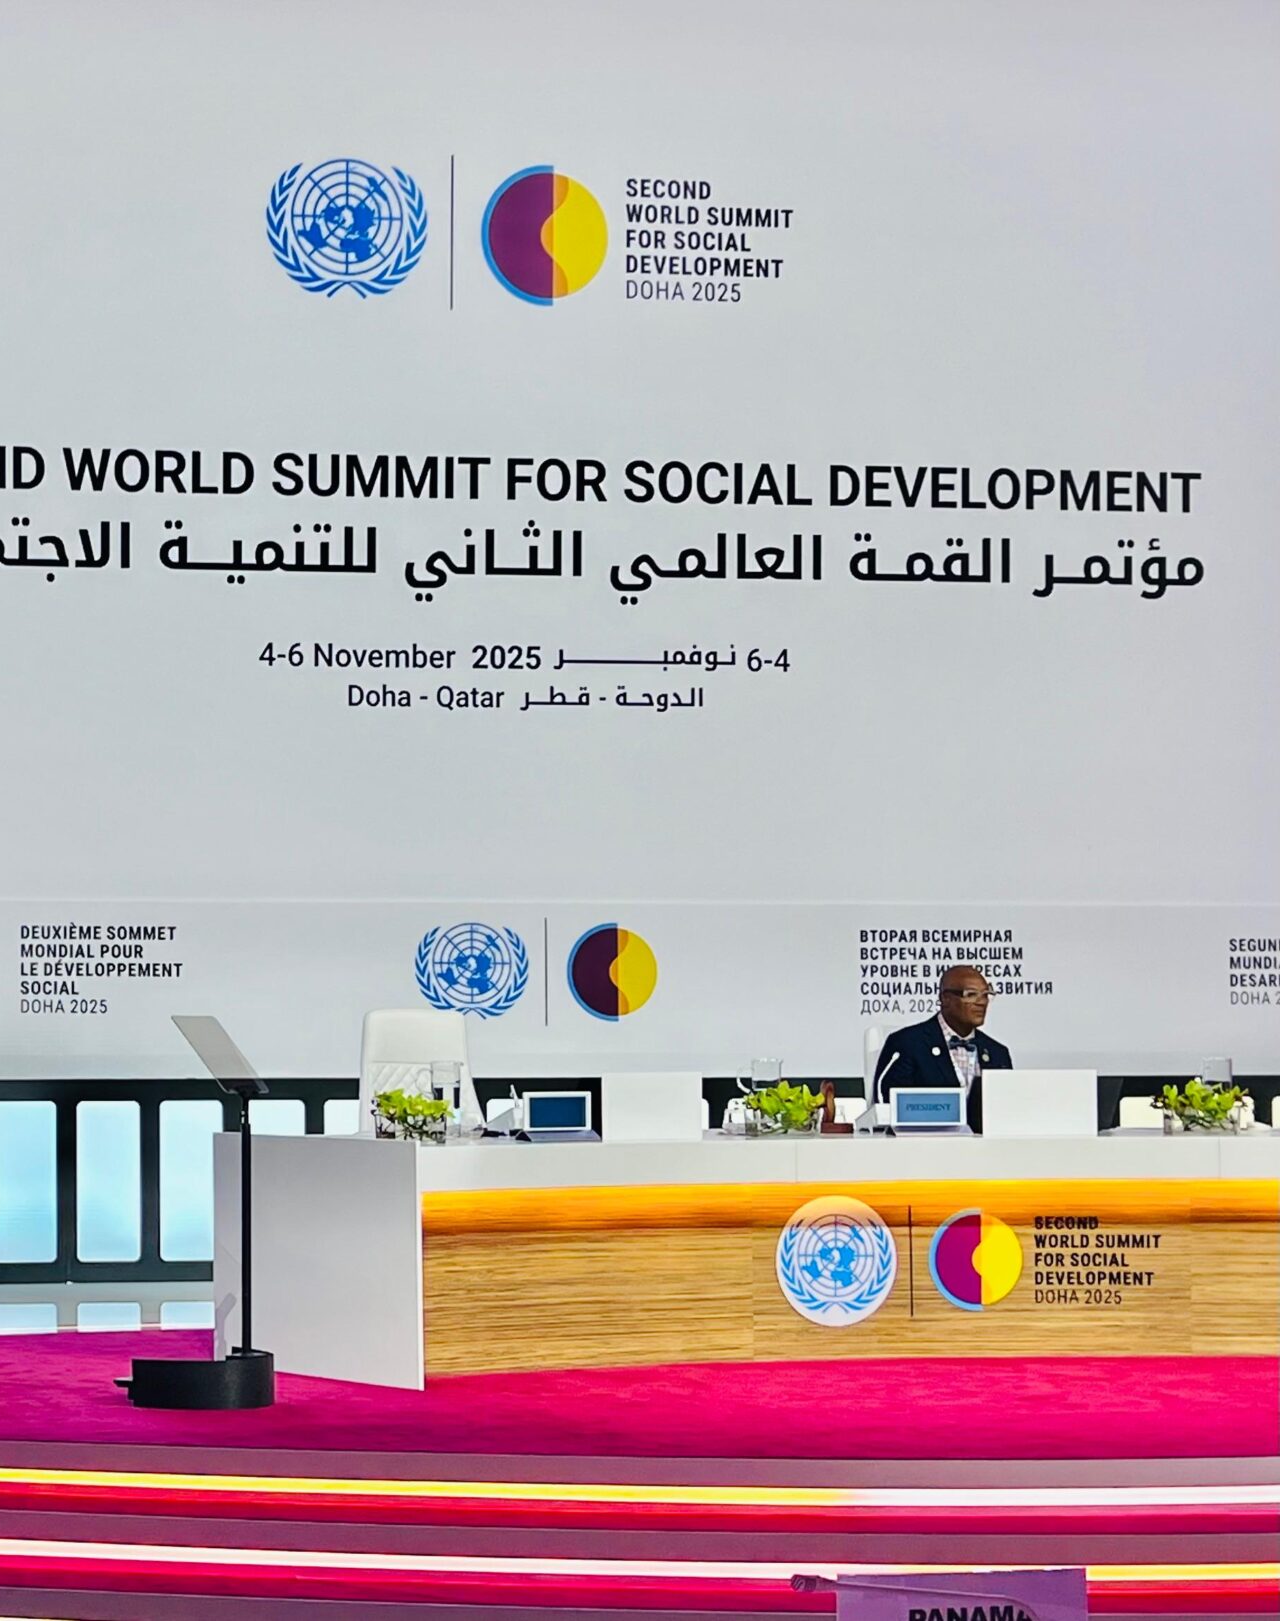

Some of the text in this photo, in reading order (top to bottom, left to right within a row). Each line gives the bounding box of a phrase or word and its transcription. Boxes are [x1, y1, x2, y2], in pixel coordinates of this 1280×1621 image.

[626, 179, 710, 199] SECOND
[626, 204, 793, 228] WORLD SUMMIT
[627, 230, 751, 252] FOR SOCIAL
[626, 255, 783, 279] DEVELOPMENT
[627, 280, 740, 302] DOHA 2025
[63, 448, 254, 494] WORLD
[272, 453, 491, 499] SUMMIT
[507, 458, 607, 501] FOR
[624, 460, 812, 505] SOCIAL
[830, 465, 1201, 513] DEVELOPMENT
[160, 520, 376, 584] للتنمية
[850, 533, 1010, 583] القمة
[405, 520, 582, 602] الثاني
[610, 533, 821, 605] العالمي
[1032, 538, 1204, 599] مؤتمر
[259, 643, 541, 669] 4-6 November 2025
[554, 645, 735, 671] نوفمبر
[349, 684, 411, 707] Doha
[437, 686, 504, 710] Qatar
[520, 686, 589, 711] قطر
[616, 686, 703, 712] الدوحة
[21, 923, 176, 940] DEUXIÈME SOMMET
[860, 930, 1012, 942] ВТОРАЯ ВСЕМИРНАЯ
[21, 944, 143, 958] MONDIAL POUR
[861, 947, 1022, 960] ВСТРЕЧА НА ВЫСШЕМ
[1229, 938, 1280, 952] SEGUN
[21, 960, 183, 977] LE DÉVELOPPEMENT
[861, 964, 1022, 977] УРОВНЕ В ИРЕСАХ
[1229, 956, 1280, 969] MUNDI
[21, 981, 79, 995] SOCIAL
[1229, 973, 1280, 987] DESAR
[21, 999, 107, 1013] DOHA 2025
[1231, 991, 1270, 1005] DOHA
[861, 1000, 904, 1015] ДОХА,
[1034, 1216, 1098, 1230] SECOND
[1034, 1234, 1161, 1248] WORLD SUMMIT
[1035, 1253, 1129, 1267] FOR SOCIAL
[1035, 1271, 1154, 1285] DEVELOPMENT
[1035, 1289, 1122, 1304] DOHA 2025
